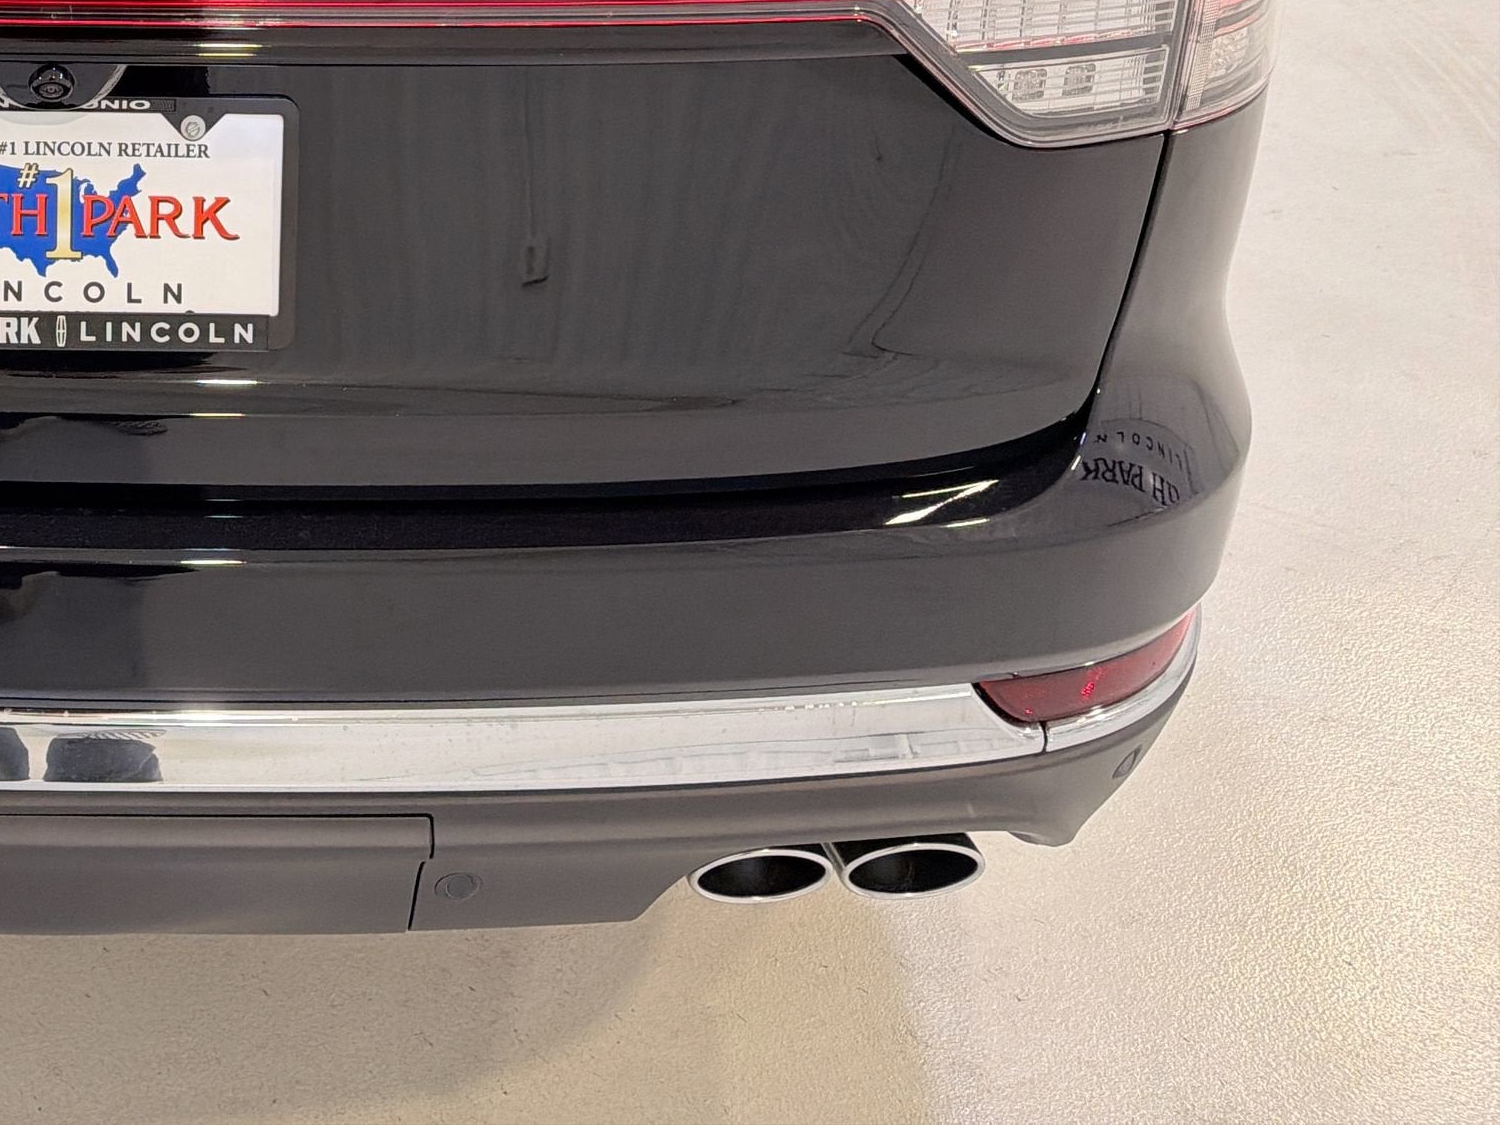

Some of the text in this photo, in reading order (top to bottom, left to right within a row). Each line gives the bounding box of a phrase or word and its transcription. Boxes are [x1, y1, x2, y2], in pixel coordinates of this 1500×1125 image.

[23, 141, 112, 158] LINCOLN
[117, 143, 210, 159] RETAILER
[81, 195, 240, 241] PARK
[80, 321, 255, 344] LINCOLN
